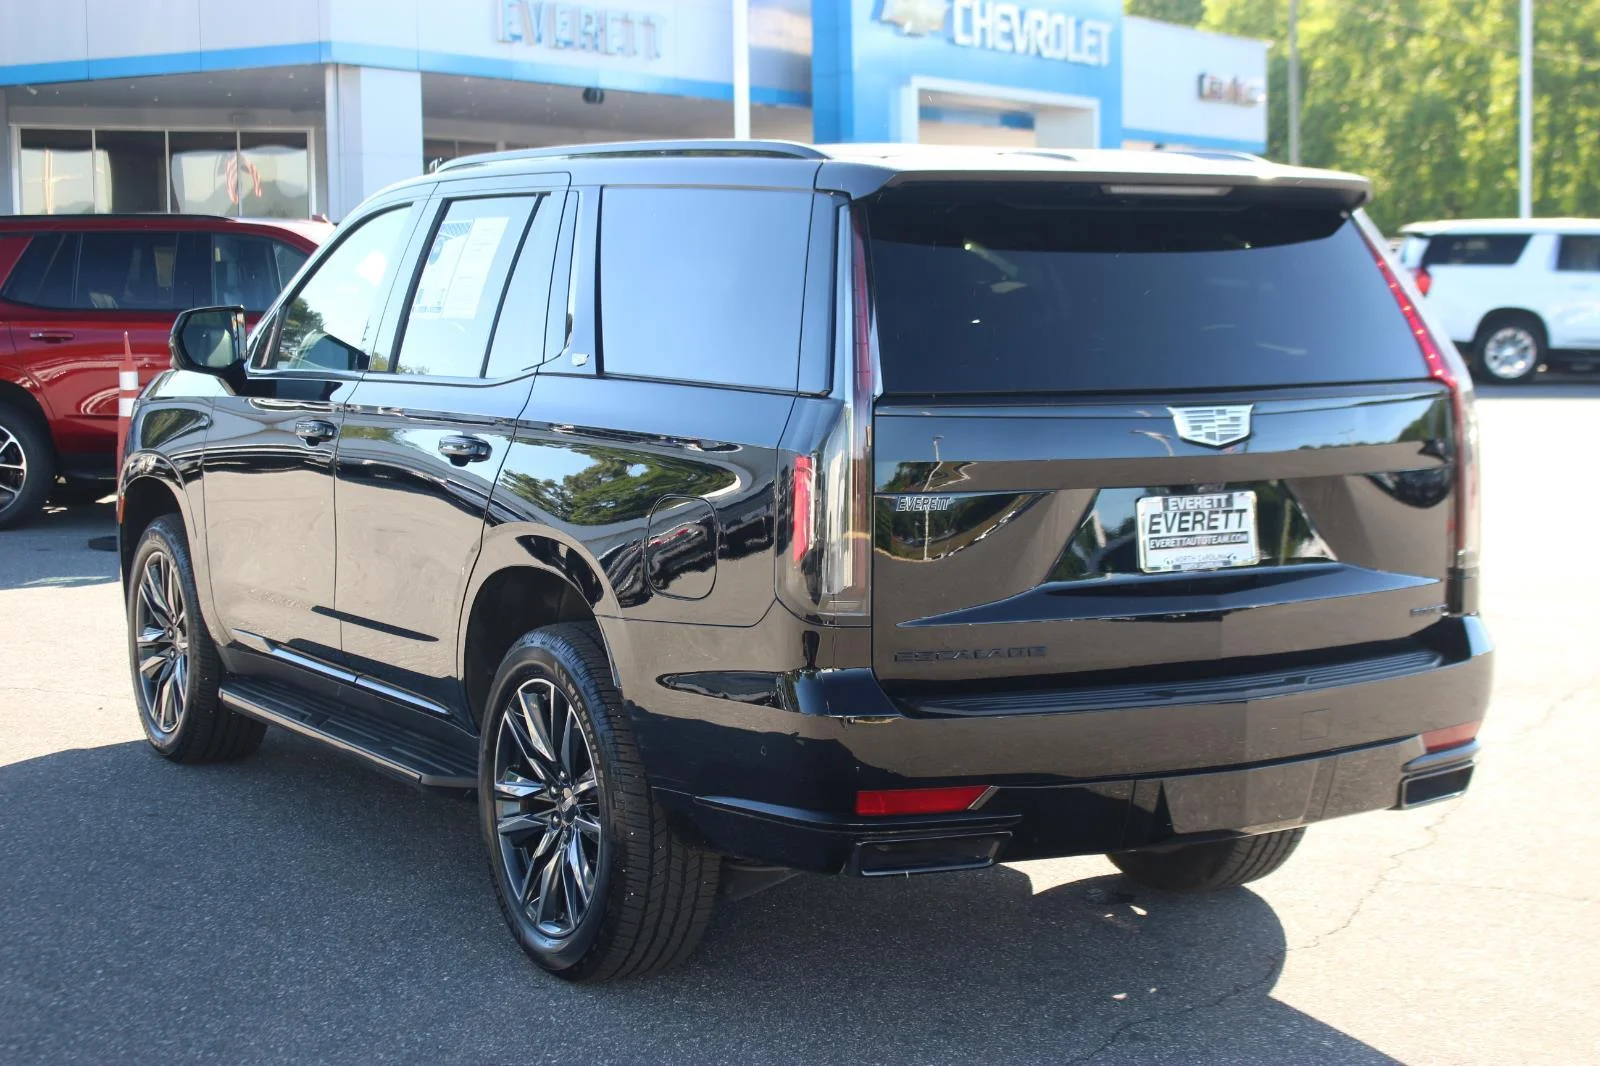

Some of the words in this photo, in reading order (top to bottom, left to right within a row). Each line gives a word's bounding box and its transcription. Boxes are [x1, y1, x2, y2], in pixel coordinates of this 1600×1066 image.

[494, 0, 666, 60] EVERETT
[954, 0, 1112, 67] CHEVROLET
[896, 496, 951, 512] EVERETT
[1168, 495, 1228, 511] EVERETT
[1148, 509, 1247, 534] EVERETT
[1149, 533, 1248, 549] EVERETTAUTOTEAM.COM
[894, 646, 1047, 662] ESCALADE
